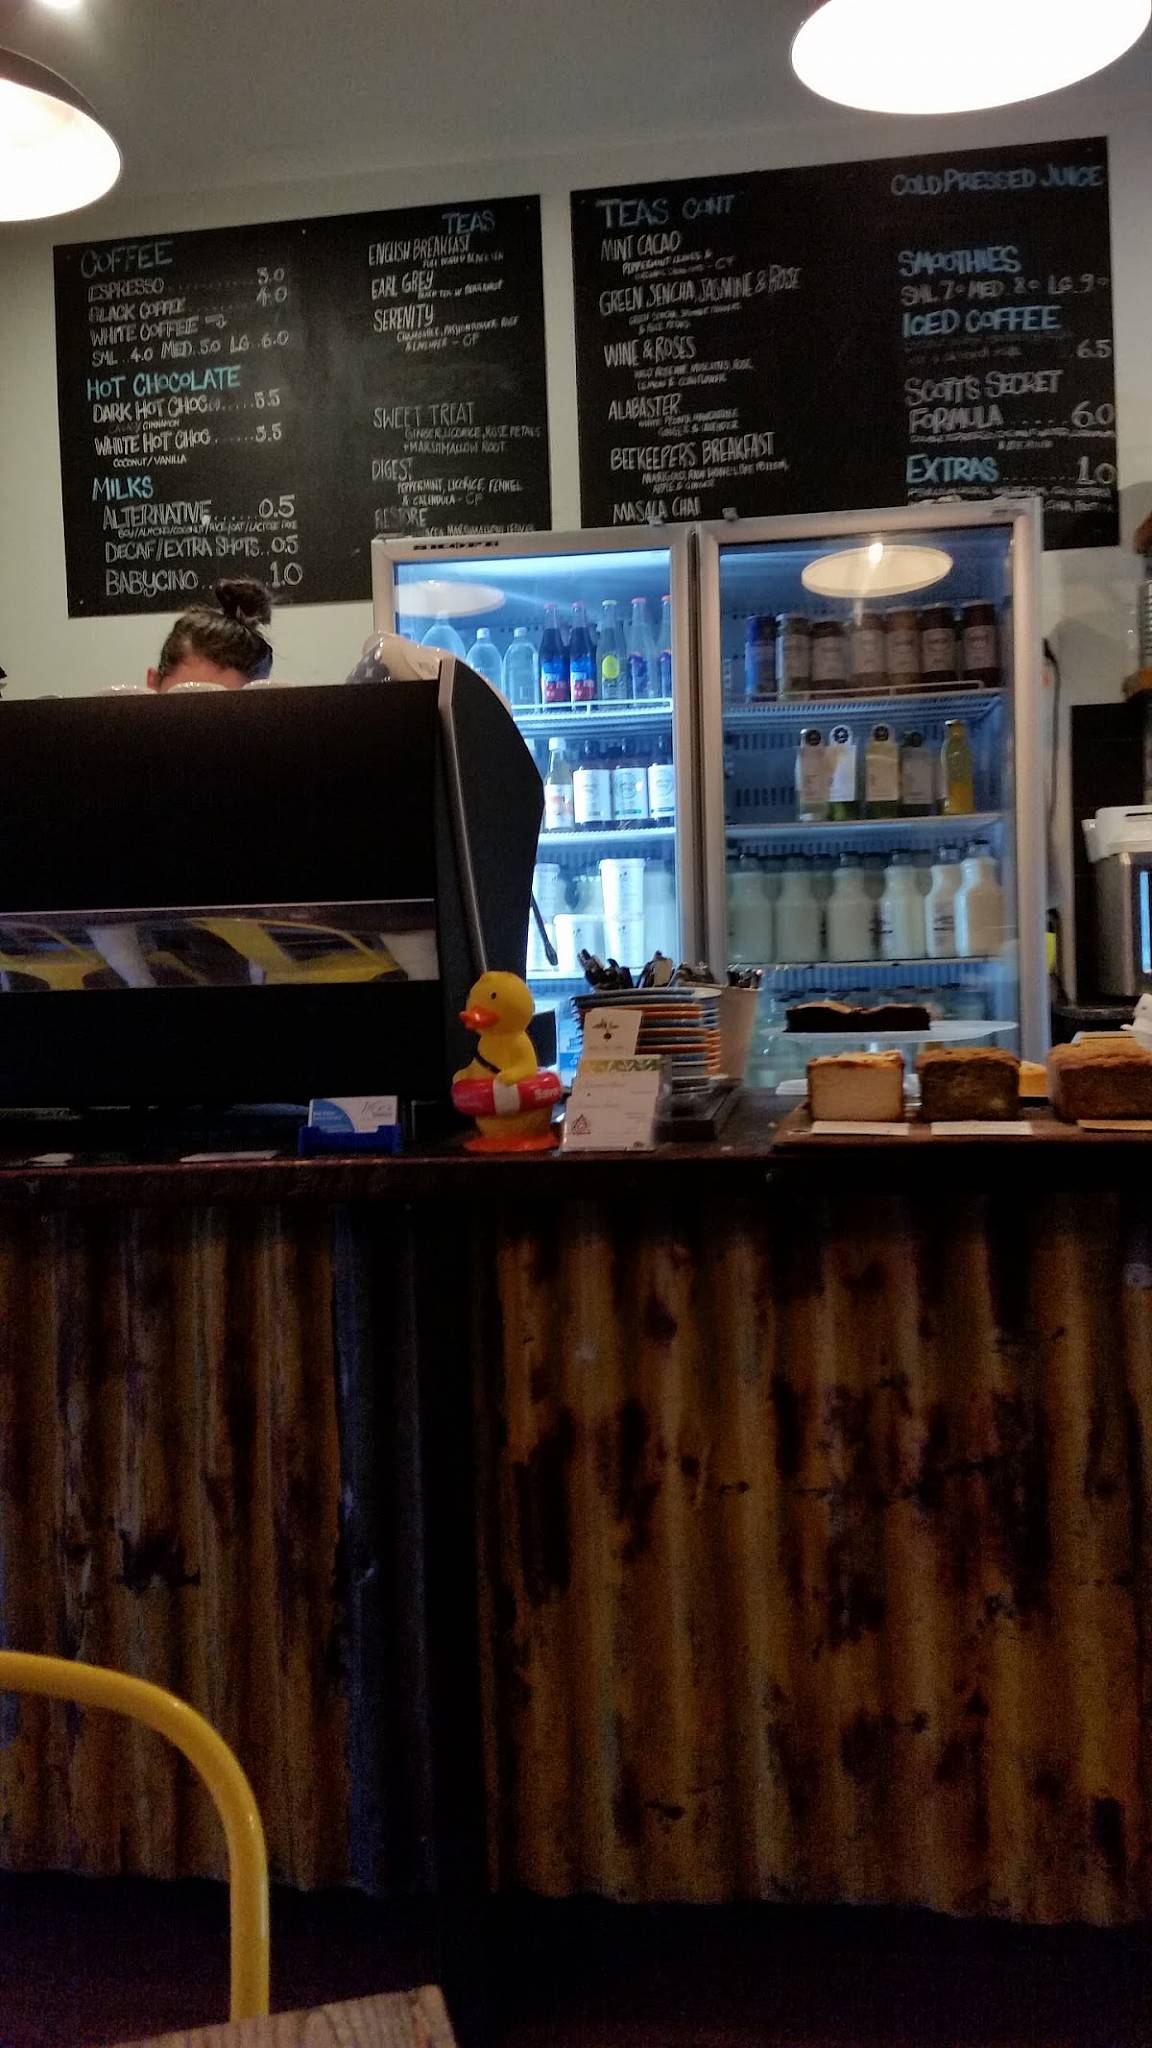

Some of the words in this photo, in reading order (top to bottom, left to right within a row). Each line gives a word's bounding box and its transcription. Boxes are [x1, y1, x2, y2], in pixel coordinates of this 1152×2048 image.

[1040, 163, 1103, 187] JUICE
[441, 209, 496, 235] TEAS
[596, 198, 668, 228] TEAS
[81, 241, 173, 278] COFFEE
[368, 240, 411, 266] ENGLISH
[412, 232, 471, 261] BREAKFAST
[601, 234, 634, 262] MINT
[637, 230, 682, 255] CACAO
[898, 246, 1022, 276] SMOOTHIES
[88, 277, 164, 302] ESPRESSO
[371, 275, 398, 300] EARL
[401, 269, 434, 294] GREY
[599, 285, 644, 316] GREEN
[699, 272, 753, 303] JASMINE
[755, 270, 767, 294] &
[968, 280, 1005, 299] MED
[89, 304, 135, 323] BLACK
[140, 297, 186, 318] COFFEE
[373, 303, 434, 333] SERENITY
[903, 309, 960, 338] ICED
[965, 305, 1062, 333] COFFEE
[90, 322, 137, 346] WHITE
[140, 315, 199, 339] COFFEE
[92, 351, 118, 368] SML
[130, 347, 154, 362] 4.0
[161, 340, 192, 359] MED
[604, 339, 638, 368] WINE
[643, 339, 655, 359] &
[655, 336, 697, 362] ROSES
[87, 376, 126, 400] HOT
[133, 365, 241, 397] CHOCOLATE
[985, 369, 1064, 398] SECRET
[93, 401, 132, 424] DARK
[135, 398, 165, 420] HOT
[254, 388, 281, 409] 5.5
[373, 405, 421, 430] SWEET
[430, 402, 475, 428] TREAT
[608, 392, 683, 421] ALABASTER
[909, 404, 1003, 434] FORMULA
[94, 434, 140, 456] WHITE
[143, 430, 172, 454] HOT
[175, 428, 211, 452] CHOC
[610, 442, 698, 471] BEEKEEPERS
[702, 431, 776, 466] BREAKFAST
[372, 456, 414, 481] DIGEST
[906, 453, 999, 484] EXTRAS
[92, 476, 154, 501] MILKS
[103, 500, 212, 531] ALTERNATIVE
[258, 495, 296, 518] 0.5
[613, 499, 668, 524] MASALA
[672, 497, 701, 518] CHAI
[215, 536, 259, 558] SHOTS
[105, 569, 199, 597] BABYCINO
[269, 561, 303, 587] 1.0
